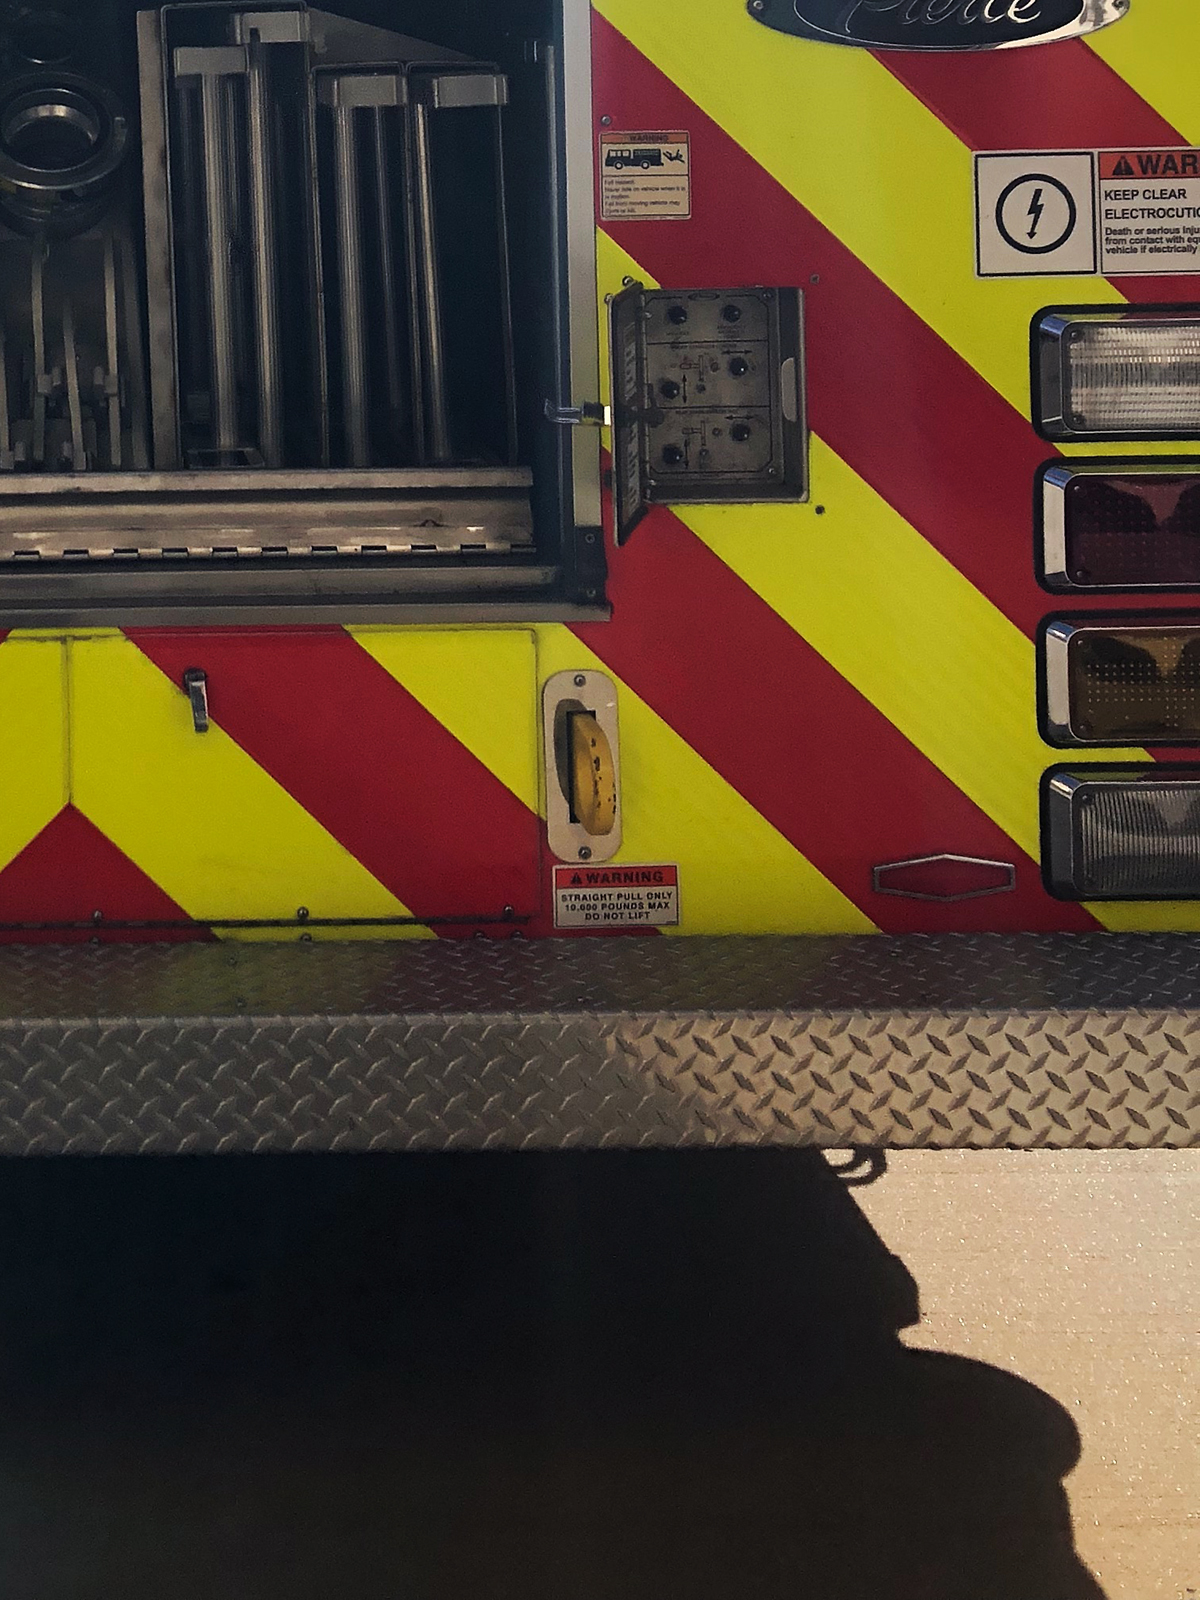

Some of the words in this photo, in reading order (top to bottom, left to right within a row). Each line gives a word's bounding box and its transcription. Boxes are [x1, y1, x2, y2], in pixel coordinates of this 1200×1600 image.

[1104, 189, 1139, 201] KEEP
[1142, 188, 1187, 200] CLEAR
[1105, 226, 1132, 236] Death
[1134, 227, 1144, 235] or
[1146, 226, 1180, 235] serious
[1104, 237, 1127, 245] from
[1129, 236, 1164, 244] contact
[1165, 236, 1185, 244] with
[1105, 245, 1138, 254] vehicle
[1140, 245, 1147, 253] if
[1148, 244, 1198, 255] electrically
[586, 871, 664, 884] WARNING
[561, 893, 614, 902] STRAIGHT
[617, 892, 643, 900] PULL
[646, 891, 673, 900] ONLY
[601, 902, 644, 910] POUNDS
[648, 901, 670, 909] MAX
[585, 912, 600, 920] DO
[603, 912, 625, 920] NOT
[628, 911, 651, 919] LIFT
